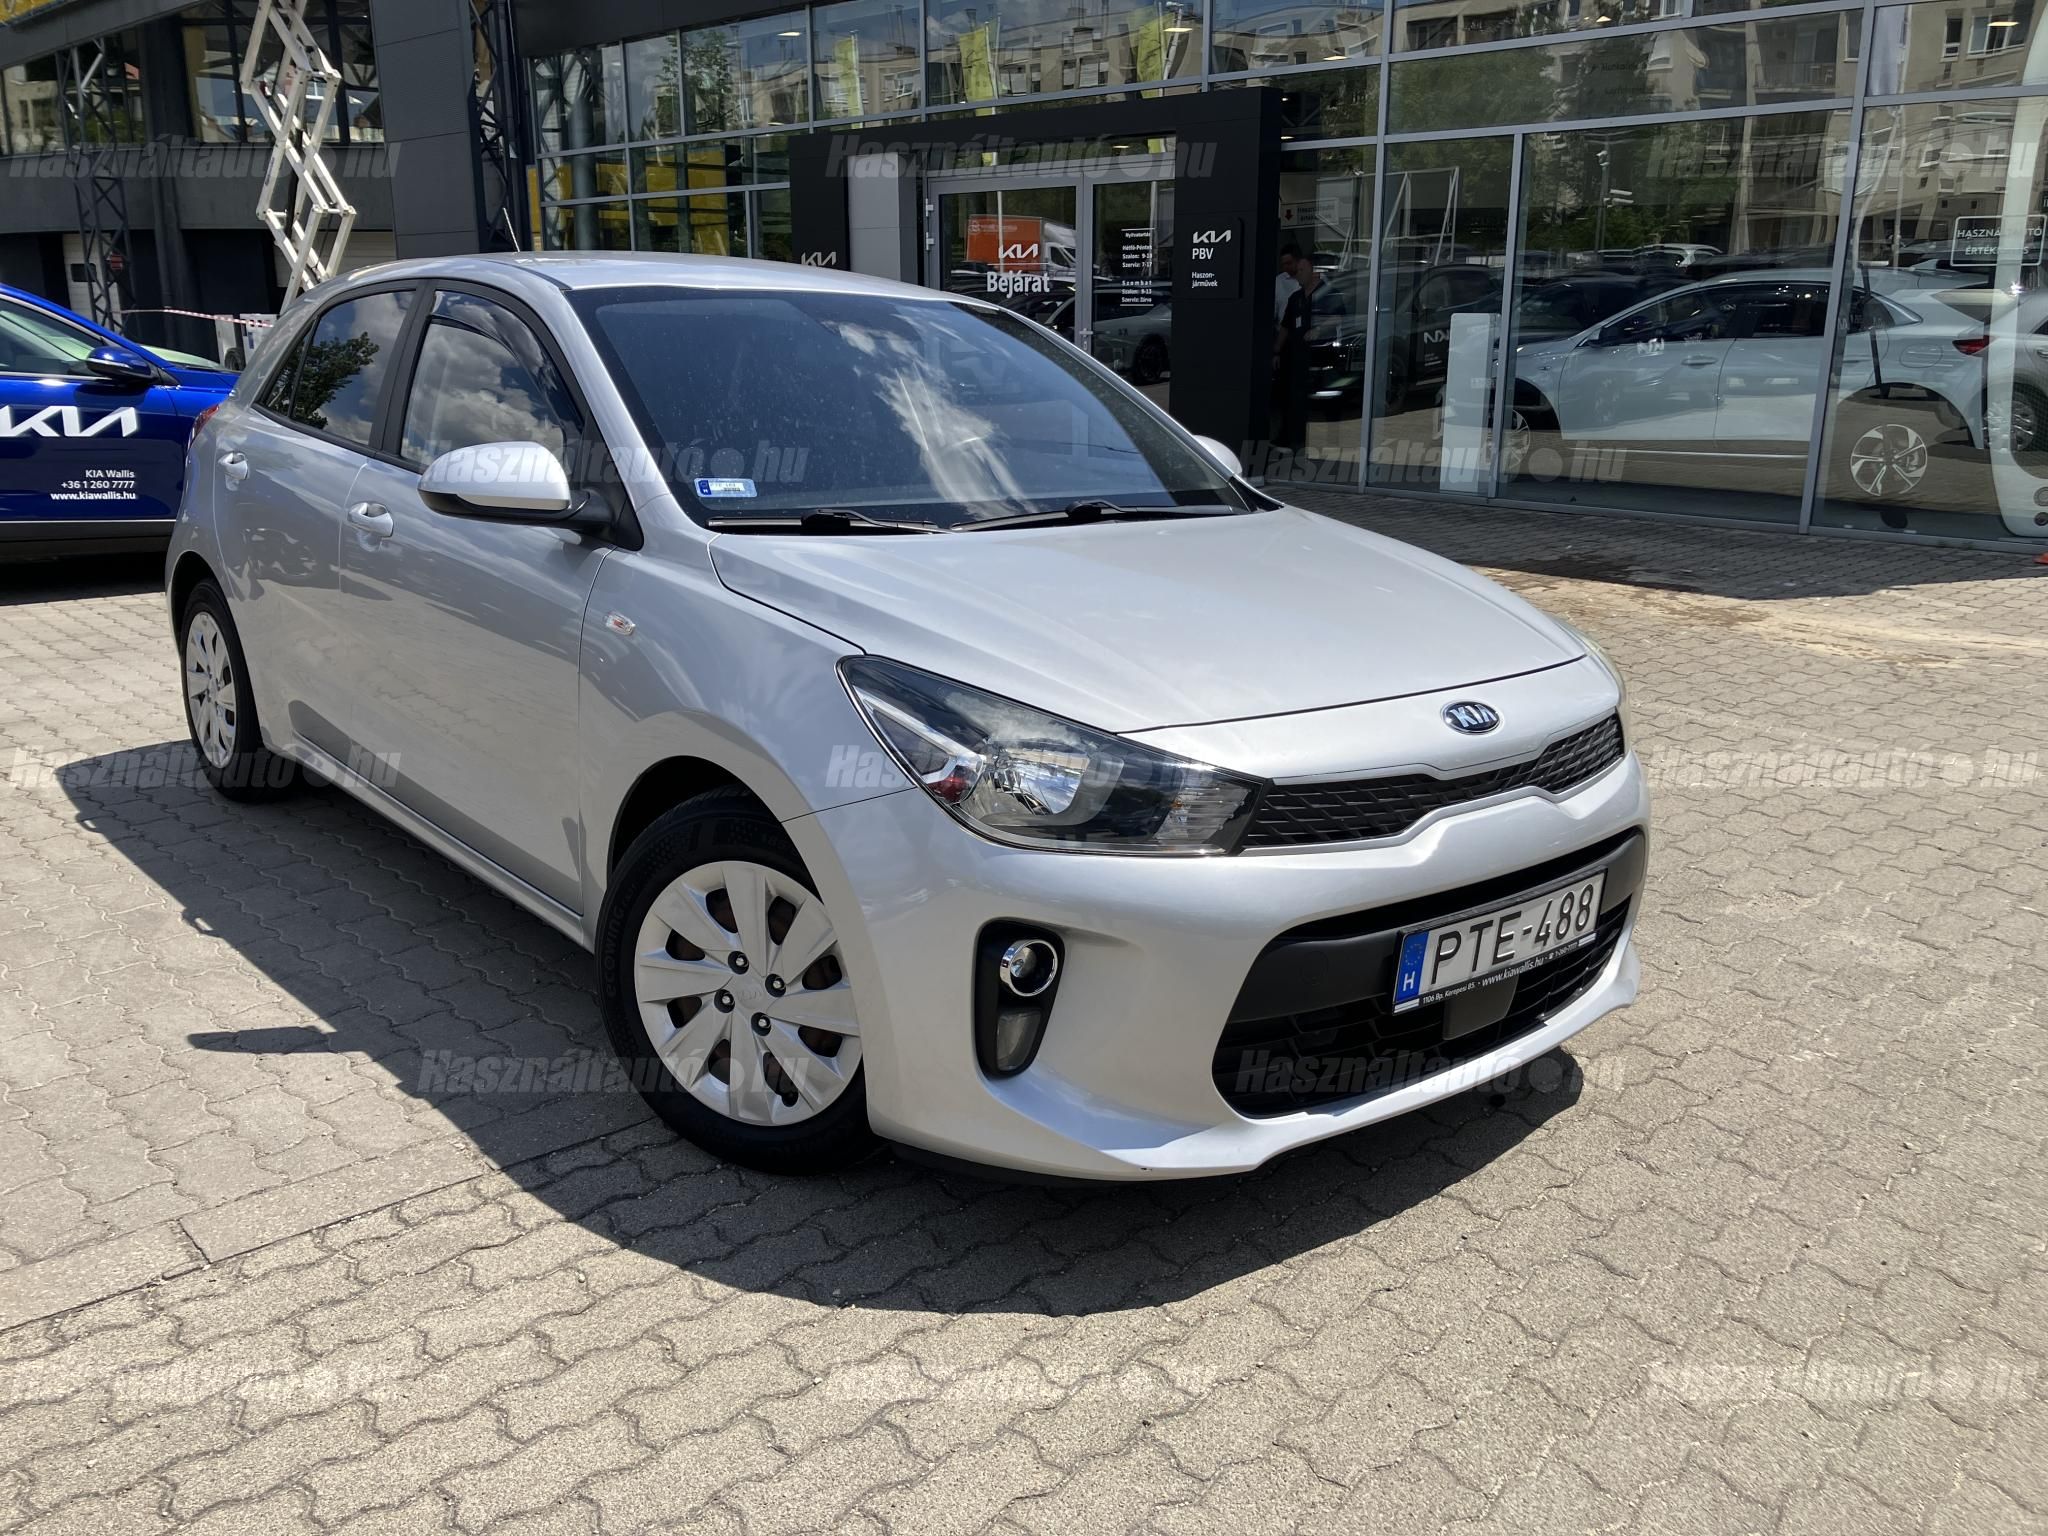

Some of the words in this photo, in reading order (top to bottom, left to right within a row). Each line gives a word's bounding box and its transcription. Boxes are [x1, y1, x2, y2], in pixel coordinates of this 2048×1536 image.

[1192, 229, 1232, 244] KIA
[801, 251, 837, 266] KIA
[998, 243, 1039, 259] KIA
[1192, 248, 1214, 260] PBV
[1191, 271, 1215, 279] Haszon-
[986, 269, 1051, 299] Bejárat
[85, 469, 104, 478] KIA
[105, 469, 135, 478] Wallis
[61, 480, 81, 489] +36
[83, 480, 89, 489] 1
[90, 480, 110, 489] 260
[111, 480, 135, 489] 7777
[50, 491, 136, 500] www.kiawallis.hu
[1449, 703, 1498, 728] KIA
[1429, 882, 1595, 986] PTE-488
[1482, 956, 1545, 987] www.kiawallis.hu
[1402, 970, 1417, 992] H
